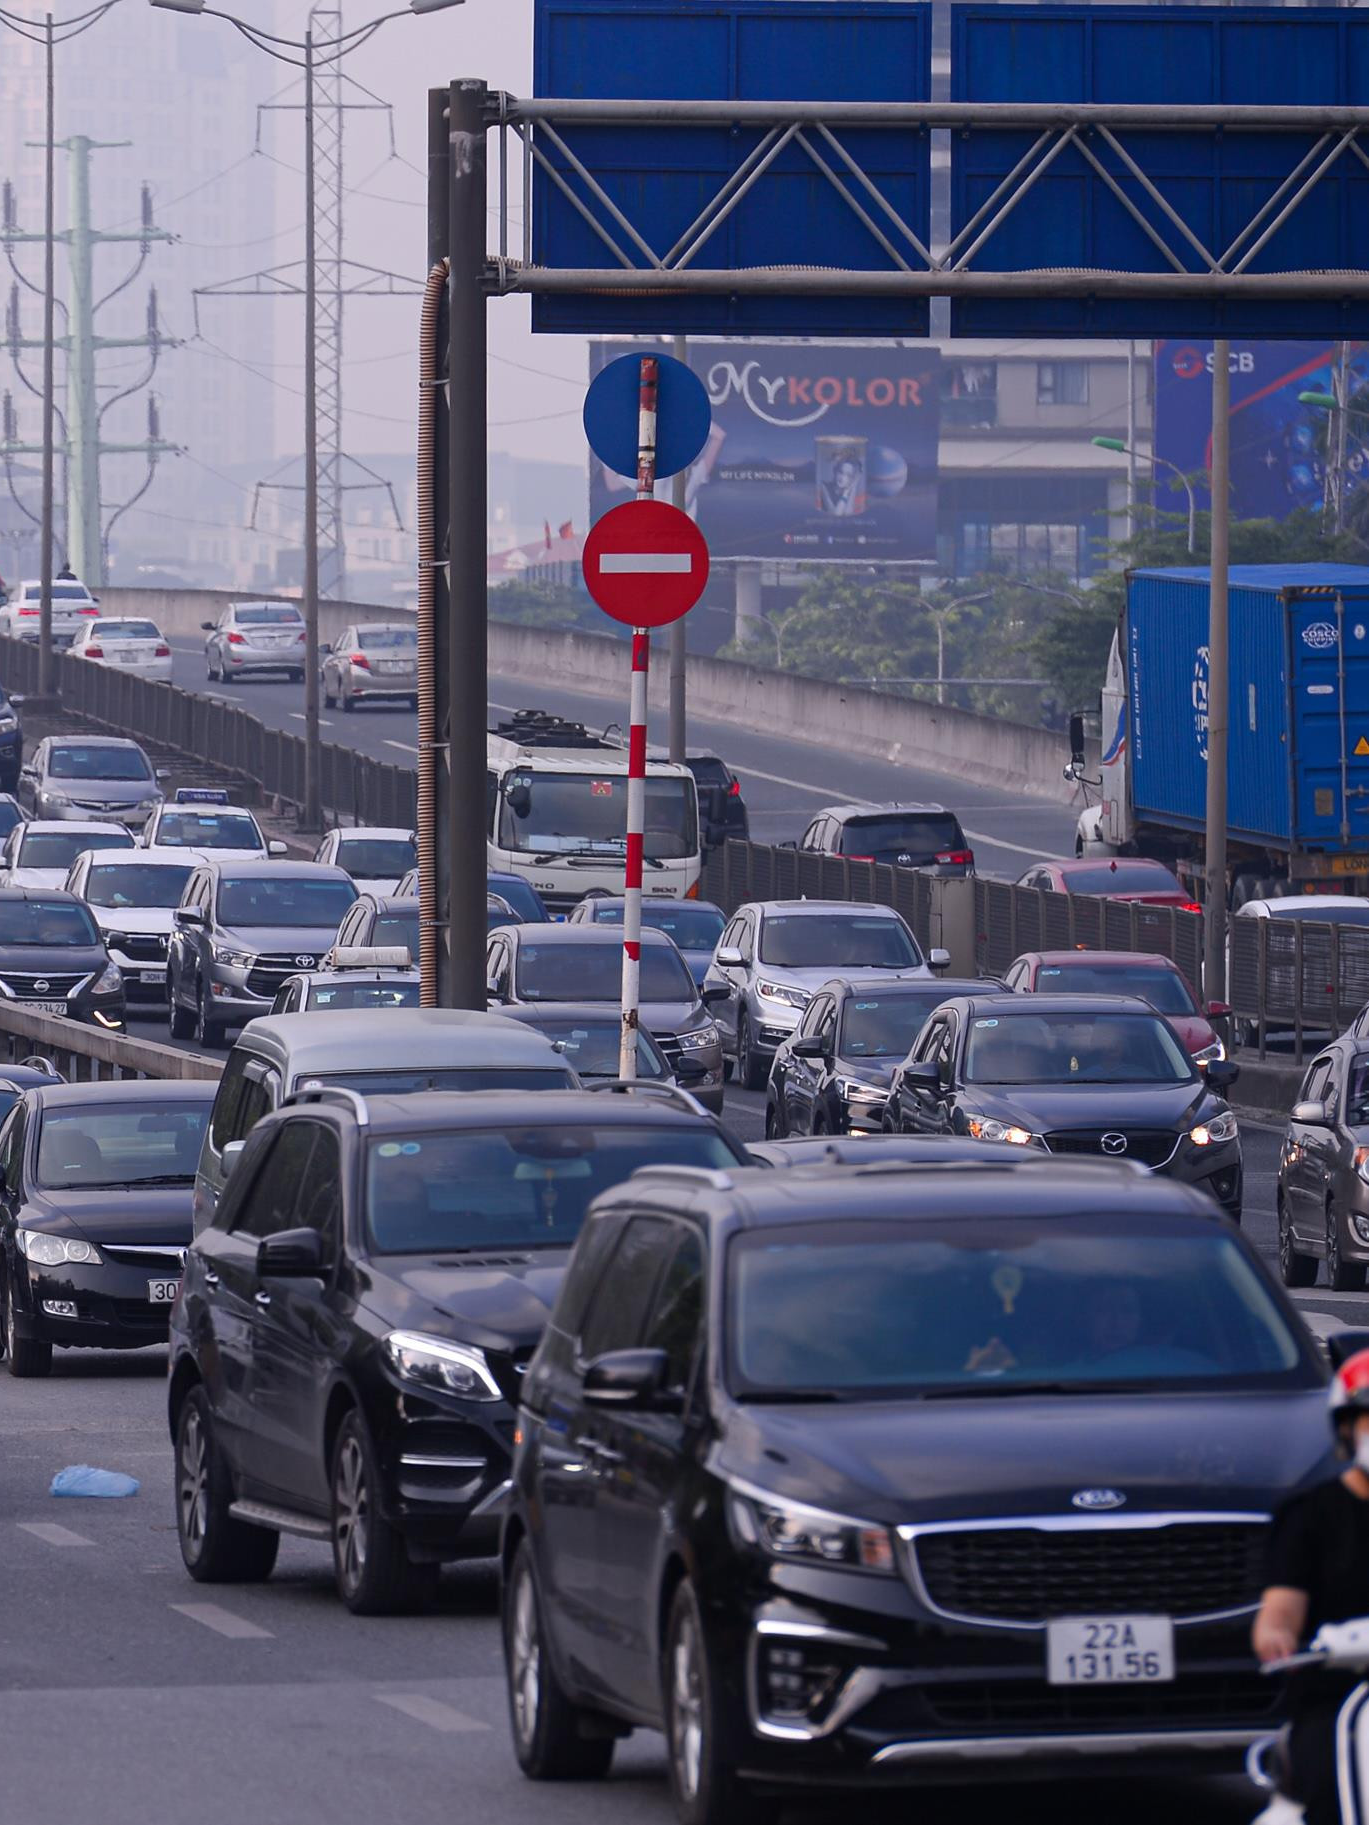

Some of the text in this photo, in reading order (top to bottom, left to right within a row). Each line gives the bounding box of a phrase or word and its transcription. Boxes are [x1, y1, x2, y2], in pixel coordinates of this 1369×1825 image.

[1301, 629, 1339, 639] COSCO
[1083, 1624, 1136, 1650] 22A
[1065, 1652, 1160, 1680] 131.56
